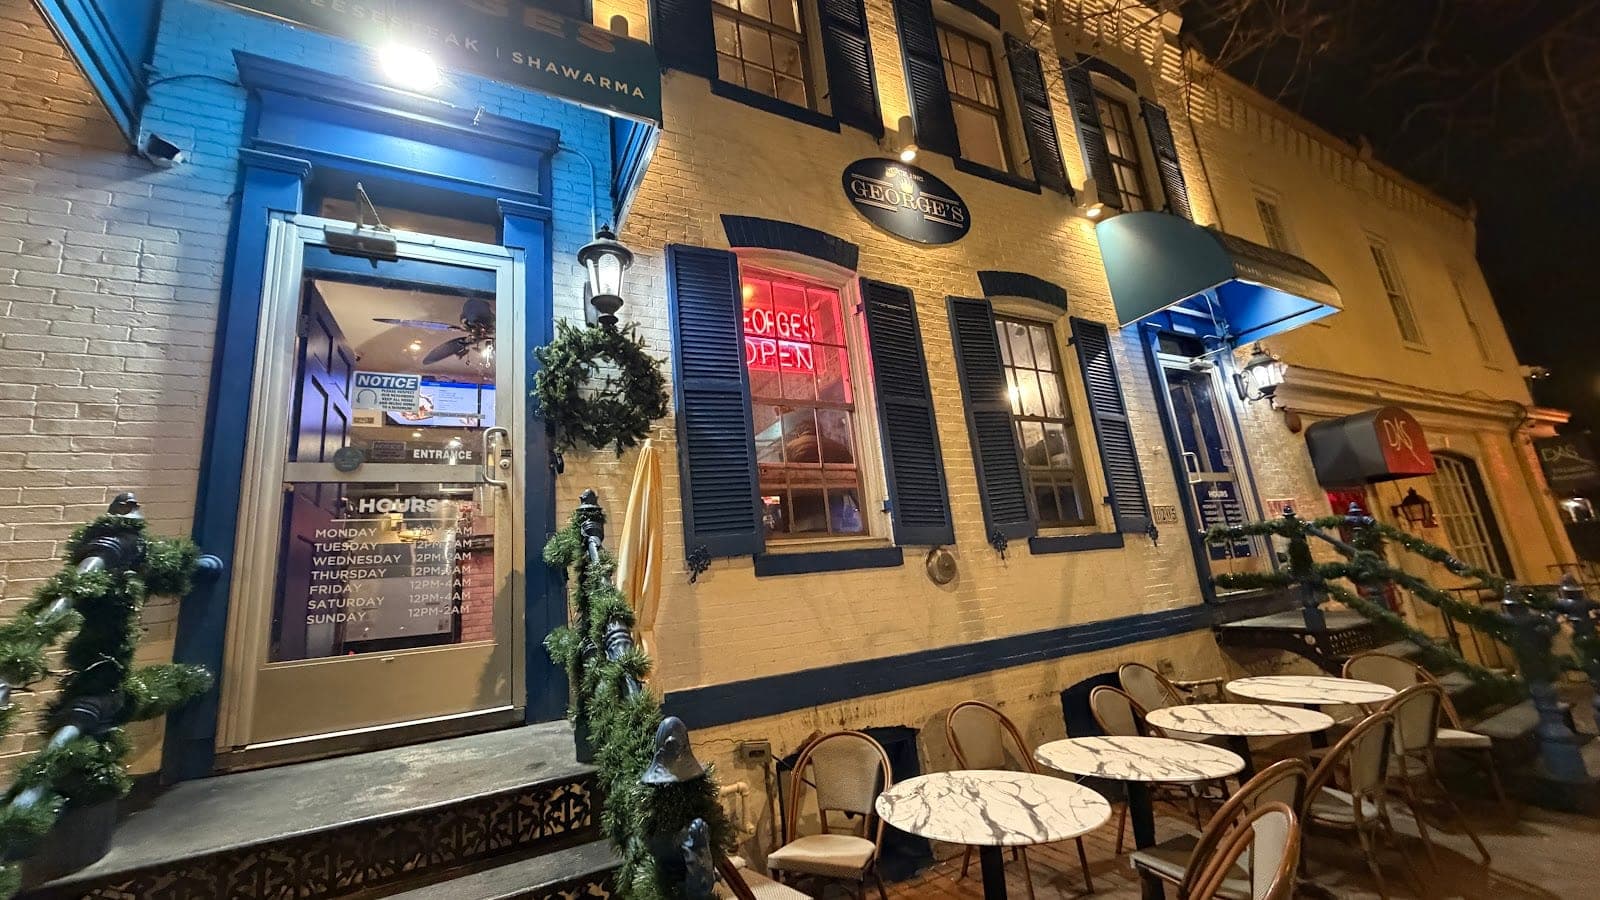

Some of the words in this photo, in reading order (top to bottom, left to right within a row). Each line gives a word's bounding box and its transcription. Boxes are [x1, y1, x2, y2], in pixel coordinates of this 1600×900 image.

[511, 51, 645, 99] SHAWARMA
[851, 179, 964, 222] GEORGE'S
[358, 375, 417, 389] NOTICE
[413, 449, 473, 460] ENTRANCE
[358, 497, 438, 513] HOURS
[315, 527, 377, 539] MONDAY
[314, 541, 378, 553] TUESDAY
[313, 554, 402, 567] WEDNESDAY
[410, 552, 472, 563] 2PM2AM
[311, 568, 387, 581] THURSDAY
[309, 583, 362, 595] FRIDAY
[409, 578, 471, 591] 12PM-4AM
[307, 596, 385, 610] SATURDAY
[409, 591, 471, 604] 12PM-4AM
[306, 611, 367, 625] SUNDAY
[408, 605, 470, 618] 12PM-2AM
